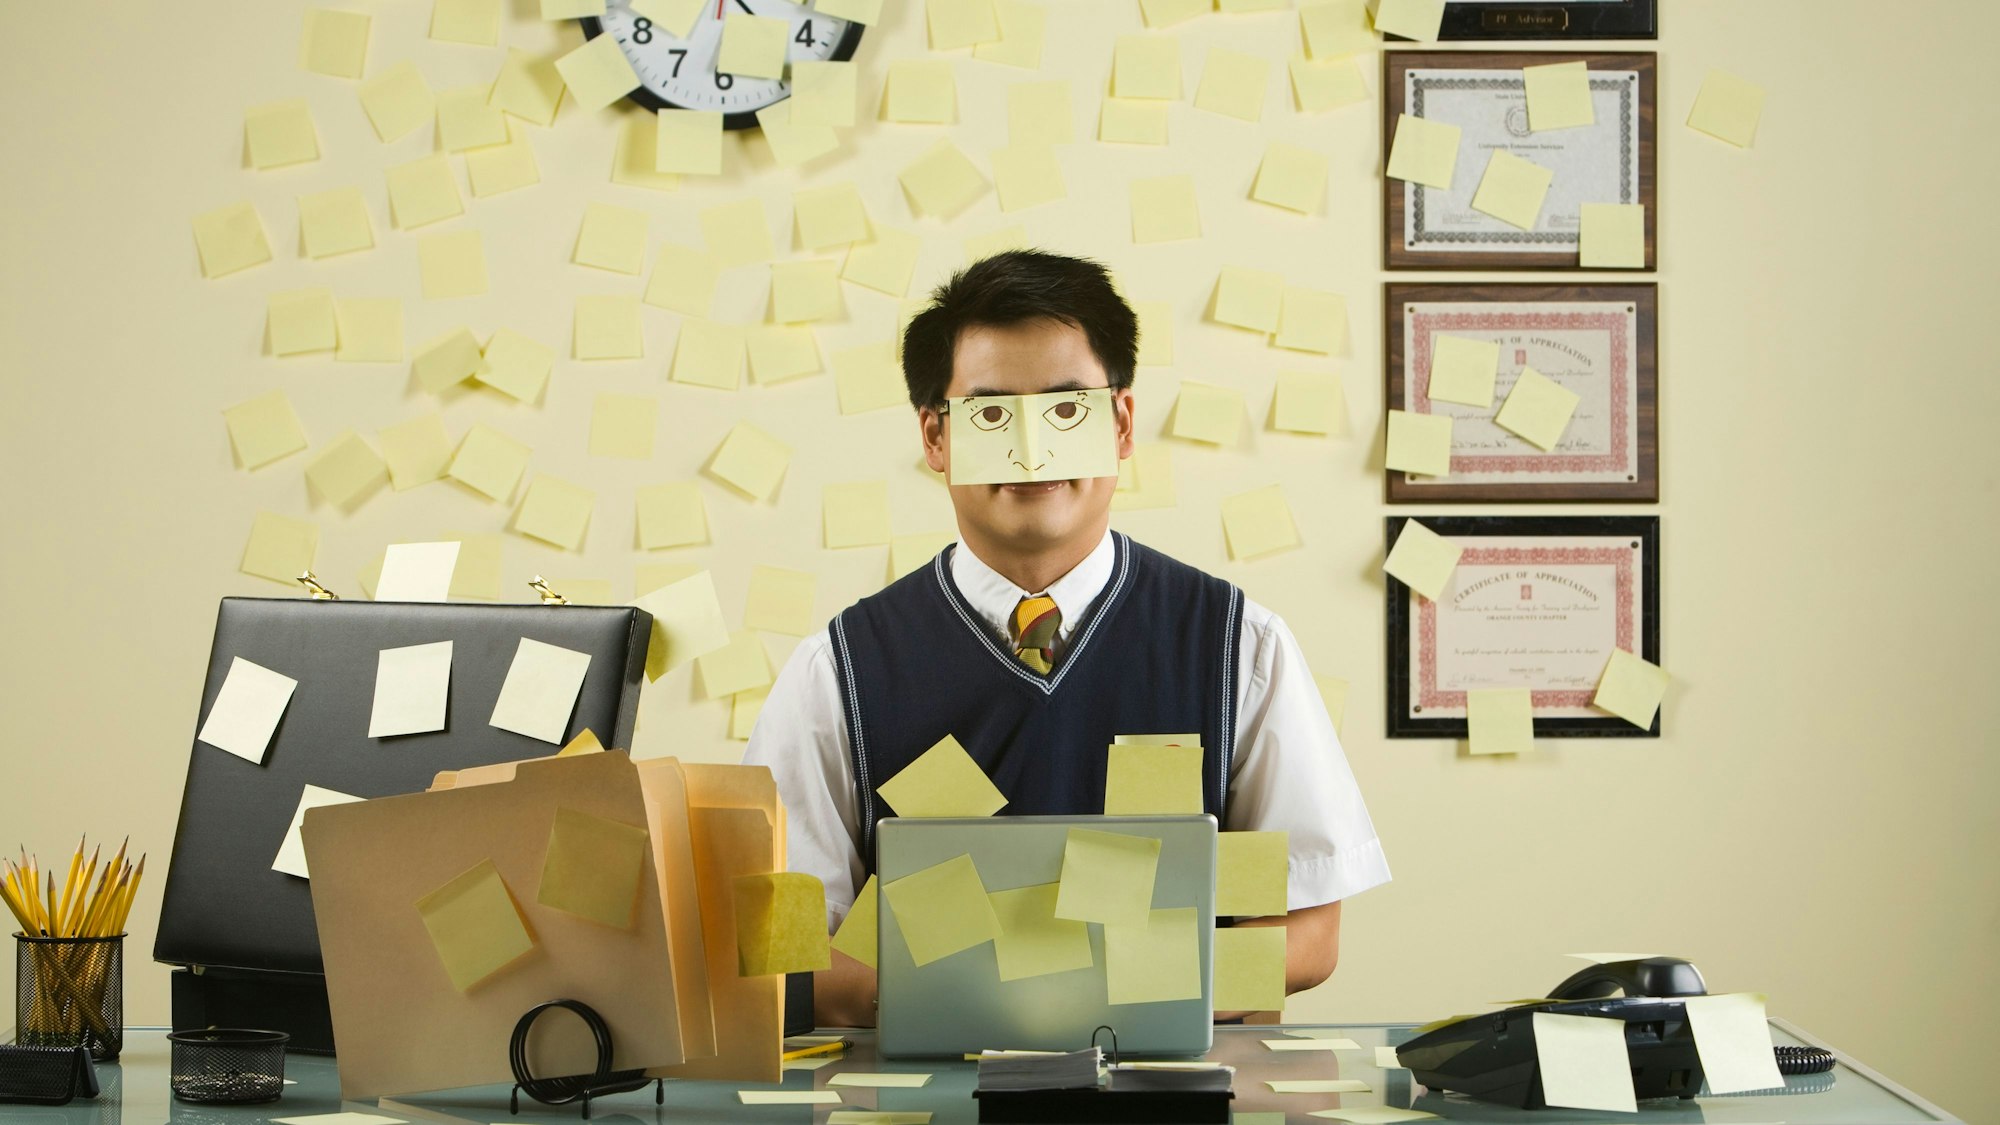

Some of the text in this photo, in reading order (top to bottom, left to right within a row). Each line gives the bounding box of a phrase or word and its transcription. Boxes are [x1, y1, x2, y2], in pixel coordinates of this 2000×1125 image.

[632, 17, 653, 45] 8
[795, 19, 816, 48] 4
[668, 49, 687, 78] 7
[714, 65, 733, 90] 6
[1510, 336, 1593, 368] OF APPRECIATION
[1454, 571, 1598, 604] CERTIFICATE OF APPRECIATION
